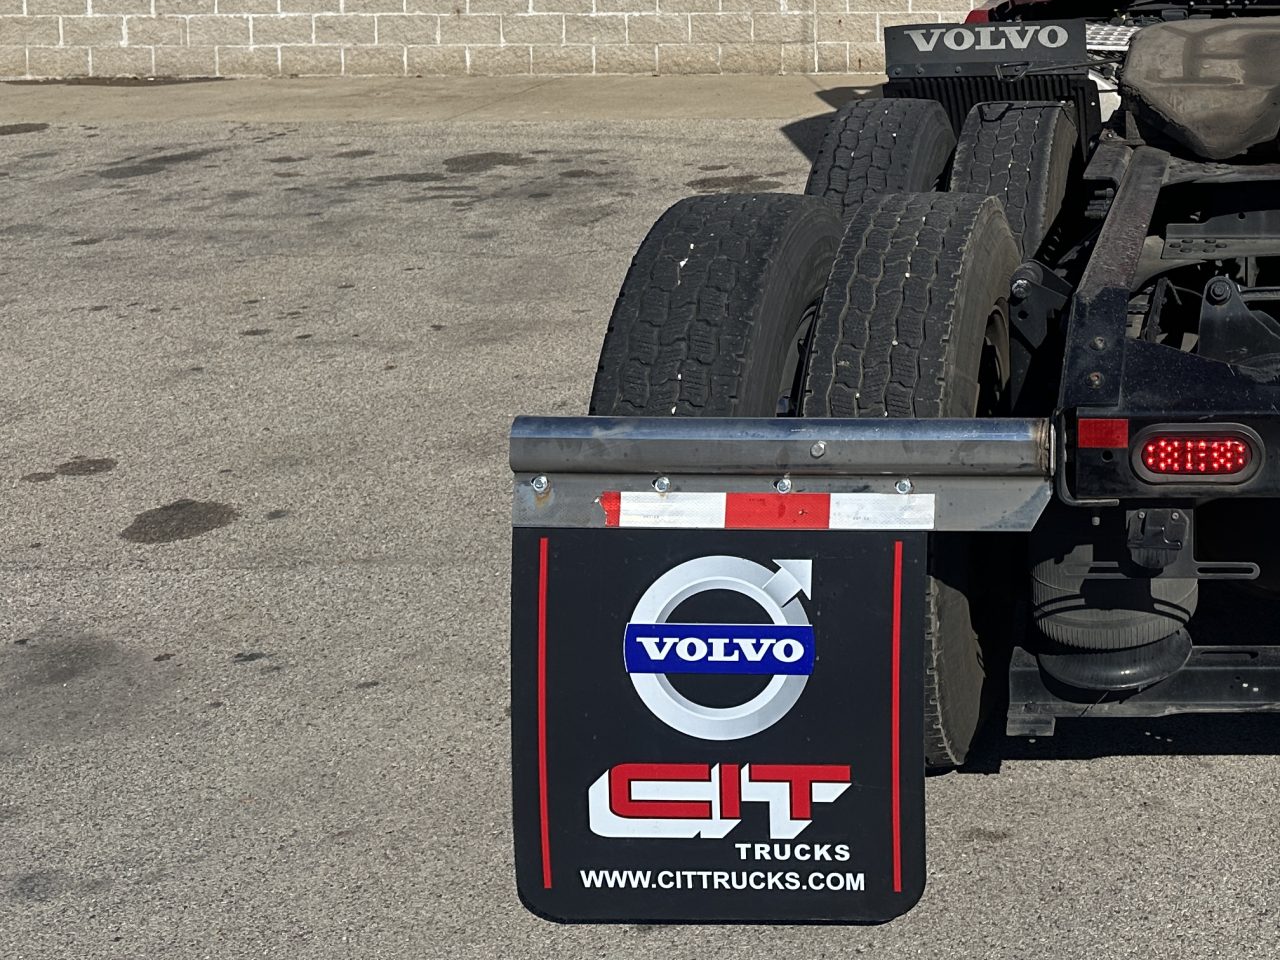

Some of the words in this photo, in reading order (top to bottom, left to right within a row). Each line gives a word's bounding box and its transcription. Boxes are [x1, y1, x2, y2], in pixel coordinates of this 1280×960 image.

[904, 25, 1069, 52] VOLVO
[636, 636, 805, 663] VOLVO
[608, 762, 852, 821] CIT
[734, 843, 851, 862] TRUCKS
[580, 870, 866, 892] WWW.CITTRUCKS.COM
